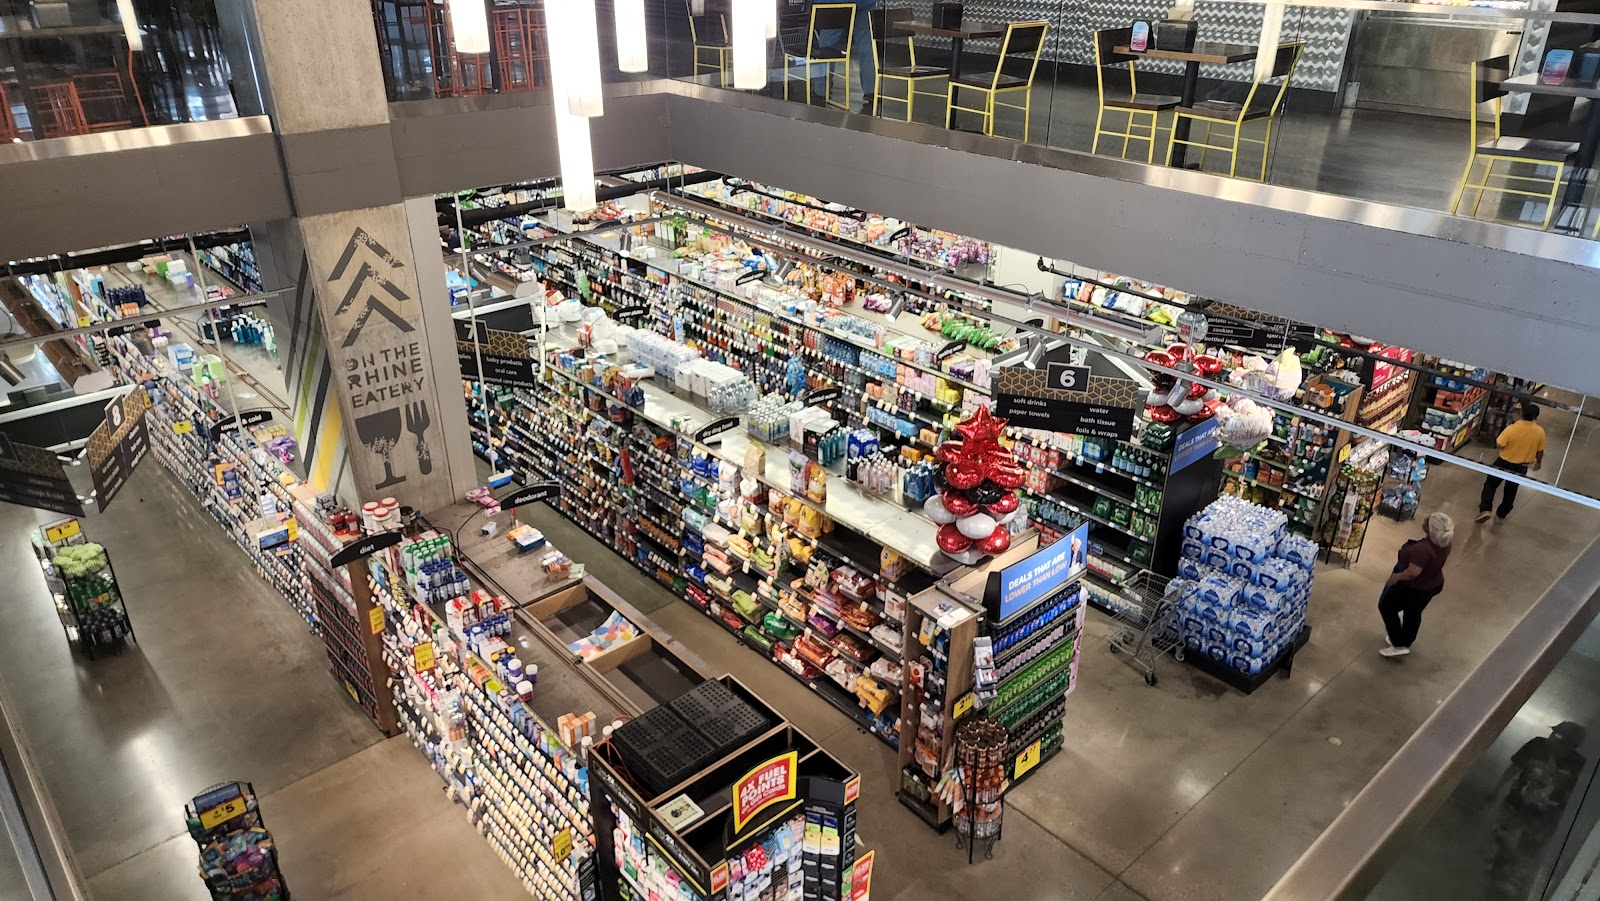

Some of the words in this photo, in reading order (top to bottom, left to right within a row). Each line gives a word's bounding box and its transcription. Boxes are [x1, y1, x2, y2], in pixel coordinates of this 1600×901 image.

[344, 353, 376, 372] ON
[380, 342, 421, 363] THE
[347, 358, 424, 391] RHINE
[1060, 369, 1076, 388] 6
[351, 377, 425, 409] EATERY
[1013, 397, 1027, 405] soft
[1027, 399, 1047, 407] drinks
[112, 404, 122, 427] 8
[248, 414, 262, 423] cold
[1009, 408, 1028, 417] paper
[1029, 411, 1050, 419] towels
[1089, 407, 1110, 415] water
[1080, 416, 1096, 425] bath
[1096, 418, 1116, 427] tissue
[1076, 426, 1091, 434] foils
[1097, 430, 1118, 439] wraps
[514, 490, 548, 504] deodorant
[359, 544, 375, 555] diet
[1008, 571, 1033, 590] DEALS
[1034, 560, 1051, 576] THAT
[1052, 551, 1066, 565] ARE
[1004, 583, 1031, 603] LOWER
[1033, 572, 1051, 587] THAN
[1052, 561, 1067, 576] LOW
[740, 780, 755, 798] 4X
[758, 765, 787, 785] FUEL
[741, 774, 785, 808] POINTS
[763, 784, 786, 797] Cards
